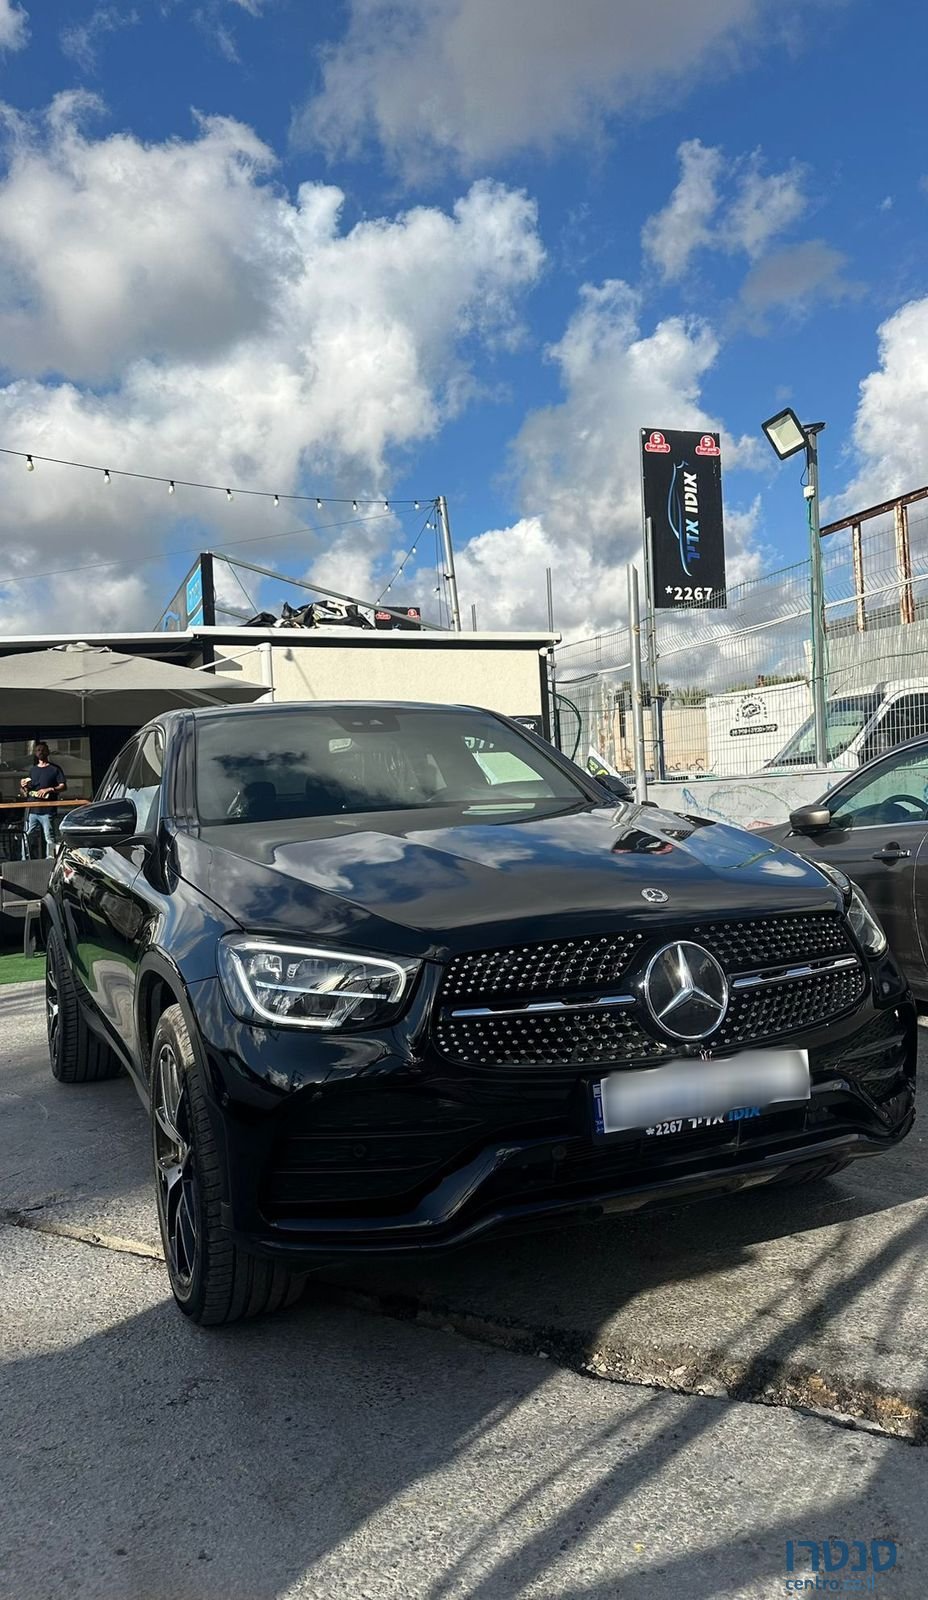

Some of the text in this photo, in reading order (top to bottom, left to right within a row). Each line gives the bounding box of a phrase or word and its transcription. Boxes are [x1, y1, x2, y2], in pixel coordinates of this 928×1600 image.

[653, 434, 661, 443] 5
[704, 438, 711, 446] 5
[683, 471, 700, 563] אוטו אדיר
